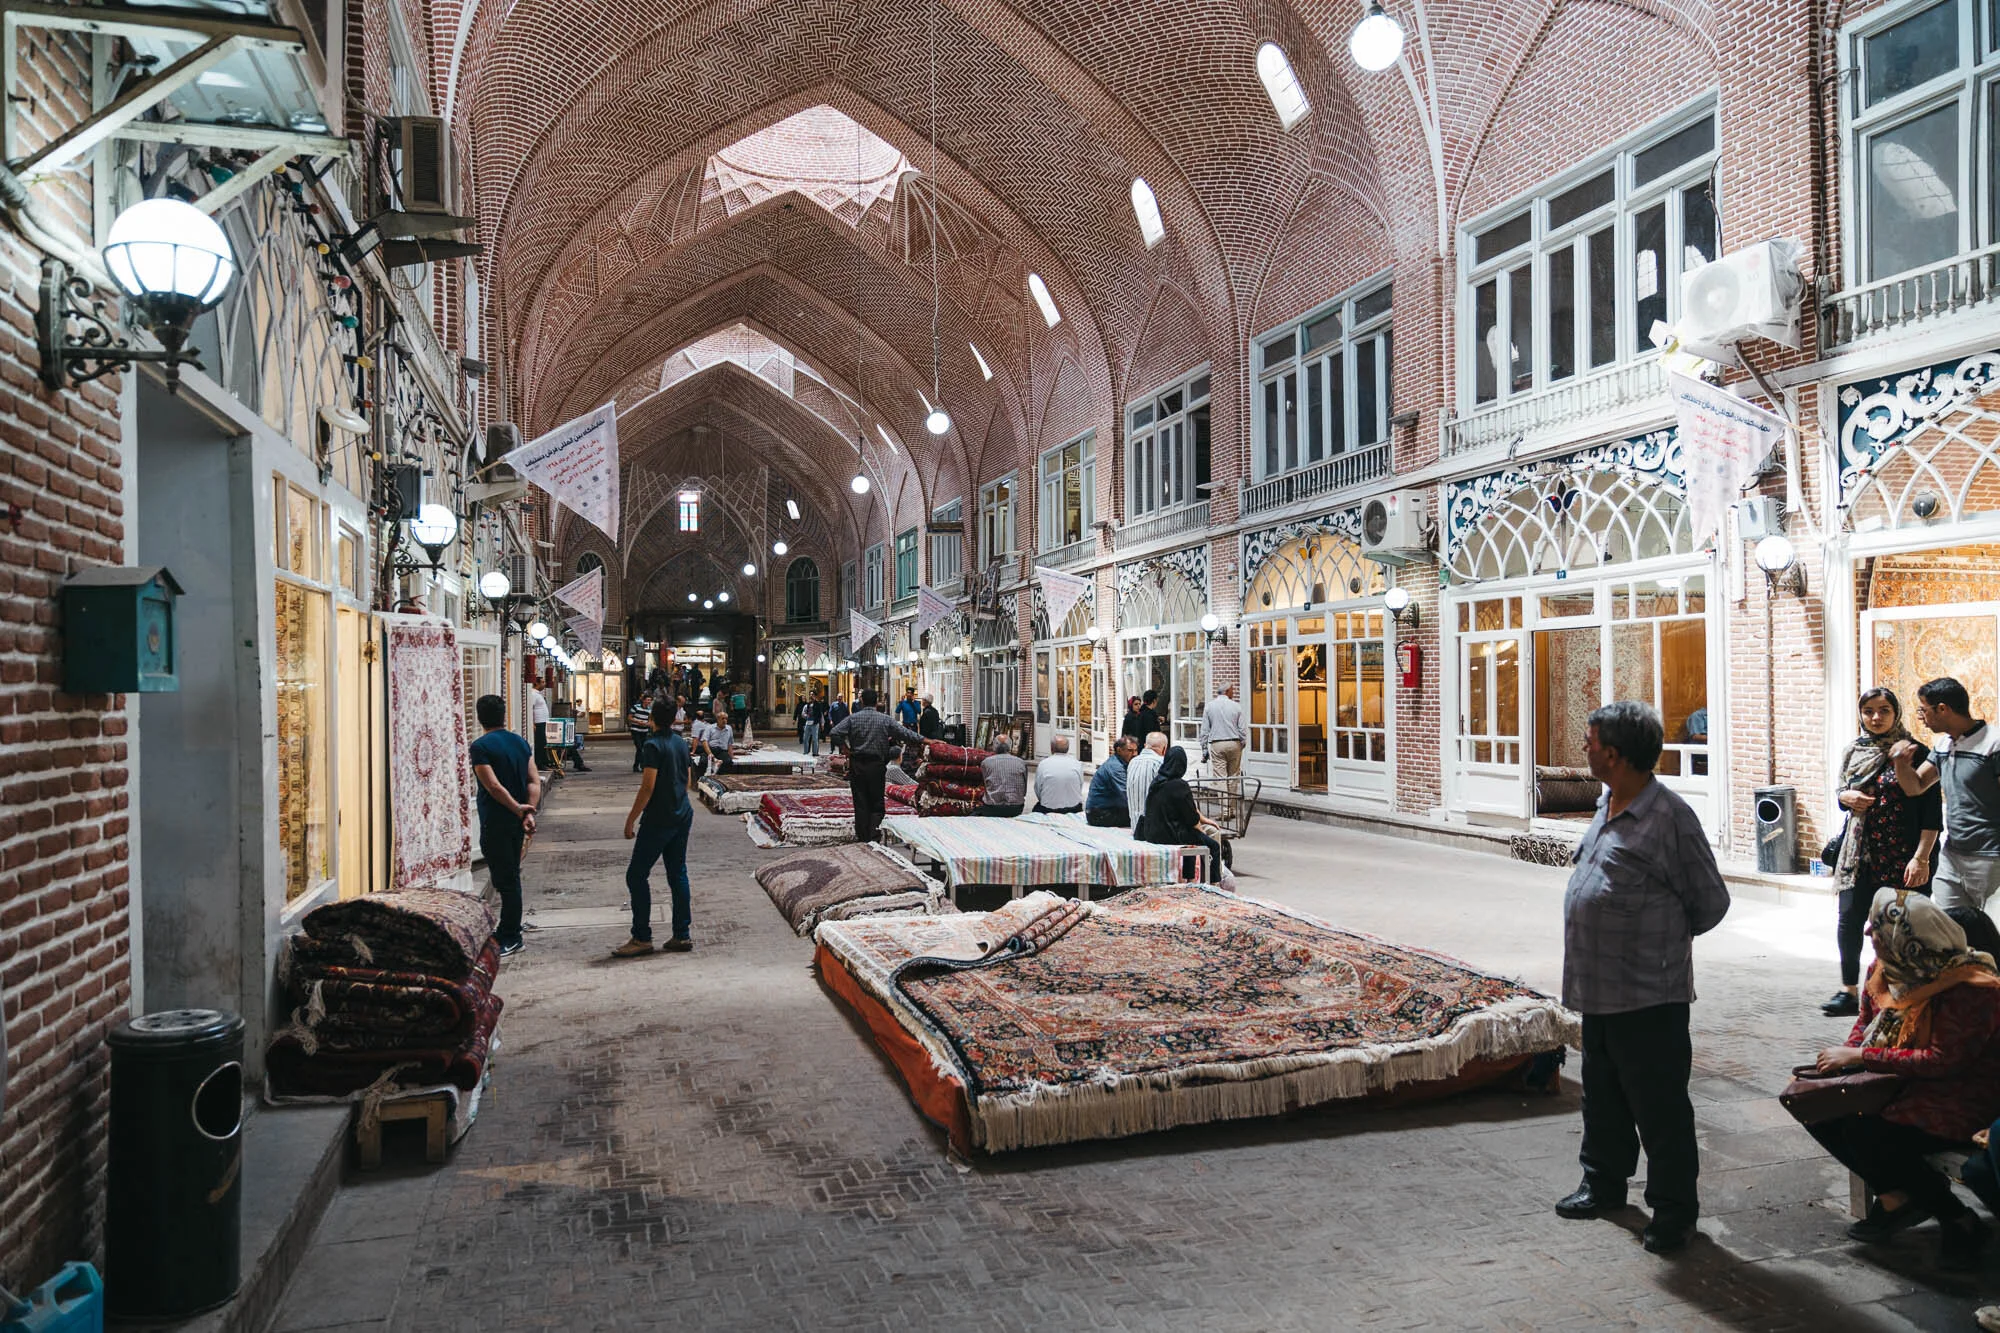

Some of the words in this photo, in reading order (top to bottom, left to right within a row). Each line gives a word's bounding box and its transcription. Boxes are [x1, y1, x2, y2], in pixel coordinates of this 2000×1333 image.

[582, 417, 605, 436] نمایشگاه
[558, 437, 574, 451] المللی
[573, 433, 583, 442] بین
